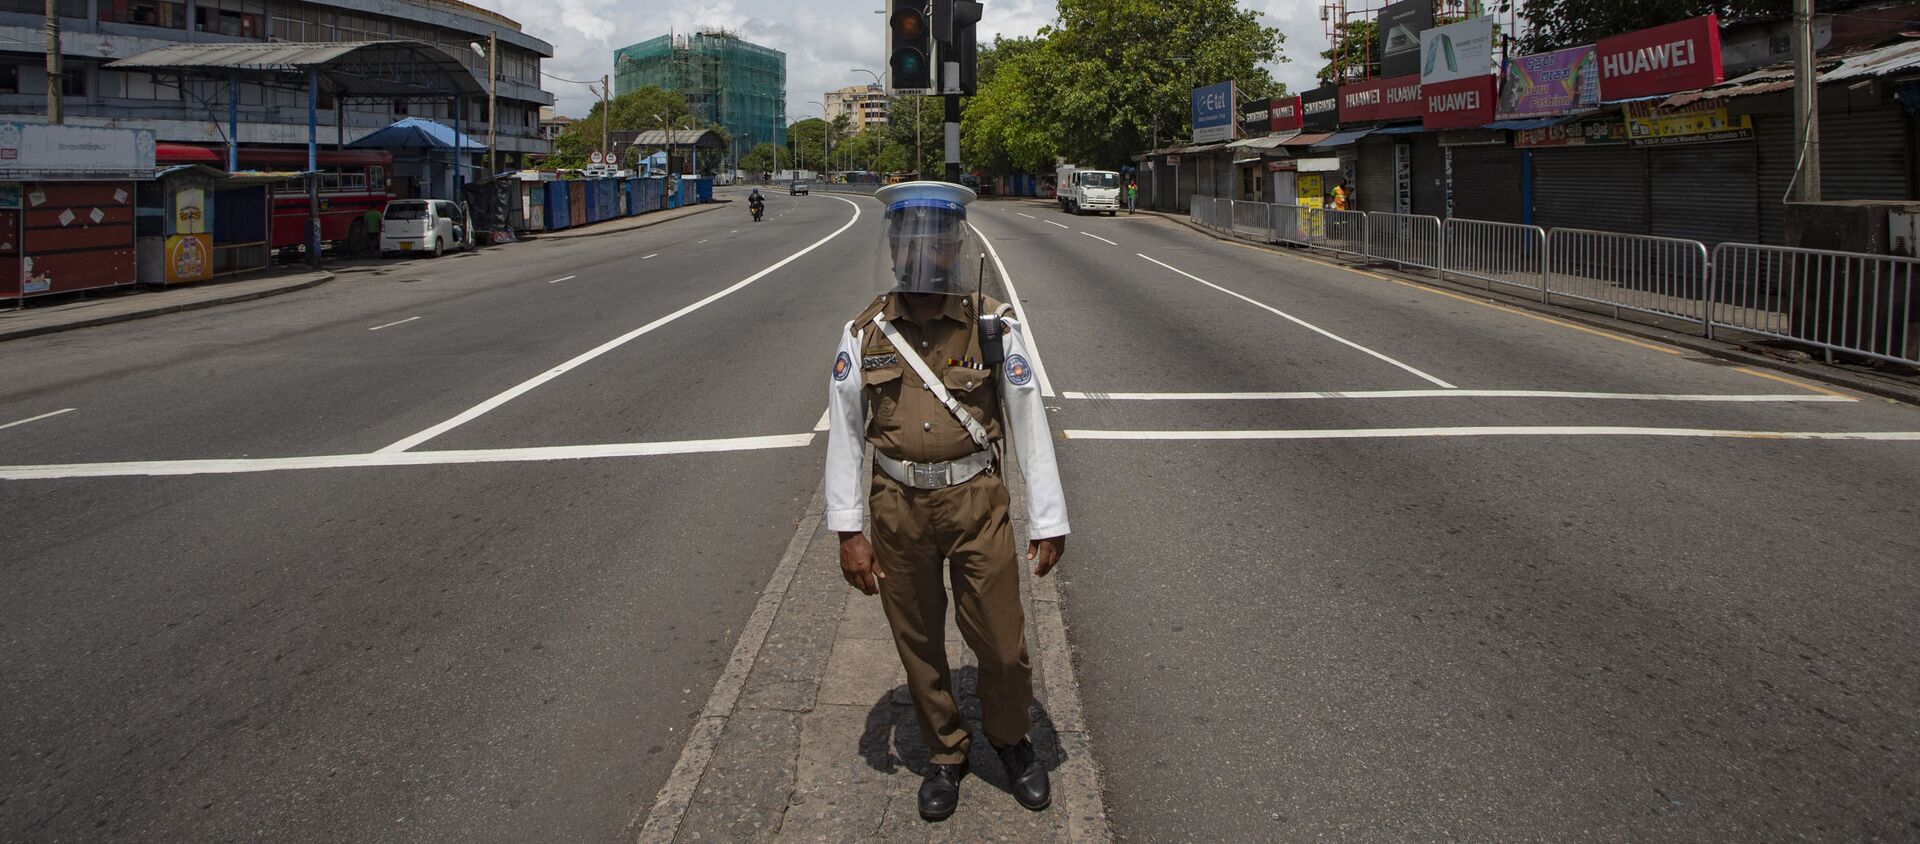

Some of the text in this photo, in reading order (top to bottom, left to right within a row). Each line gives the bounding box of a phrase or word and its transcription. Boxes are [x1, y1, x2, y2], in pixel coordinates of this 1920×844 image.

[1603, 39, 1696, 79] HUAWEI
[1387, 84, 1422, 104] HUAWE
[1524, 84, 1549, 96] Isuru
[1346, 88, 1380, 108] HUAWEI
[1428, 90, 1480, 113] HUAWEI
[1530, 95, 1569, 108] Fashion
[1272, 105, 1294, 119] HUAWEI
[1304, 98, 1336, 115] SAMSUNG
[1245, 110, 1268, 123] SAMSUNG
[1708, 132, 1738, 140] Colombo
